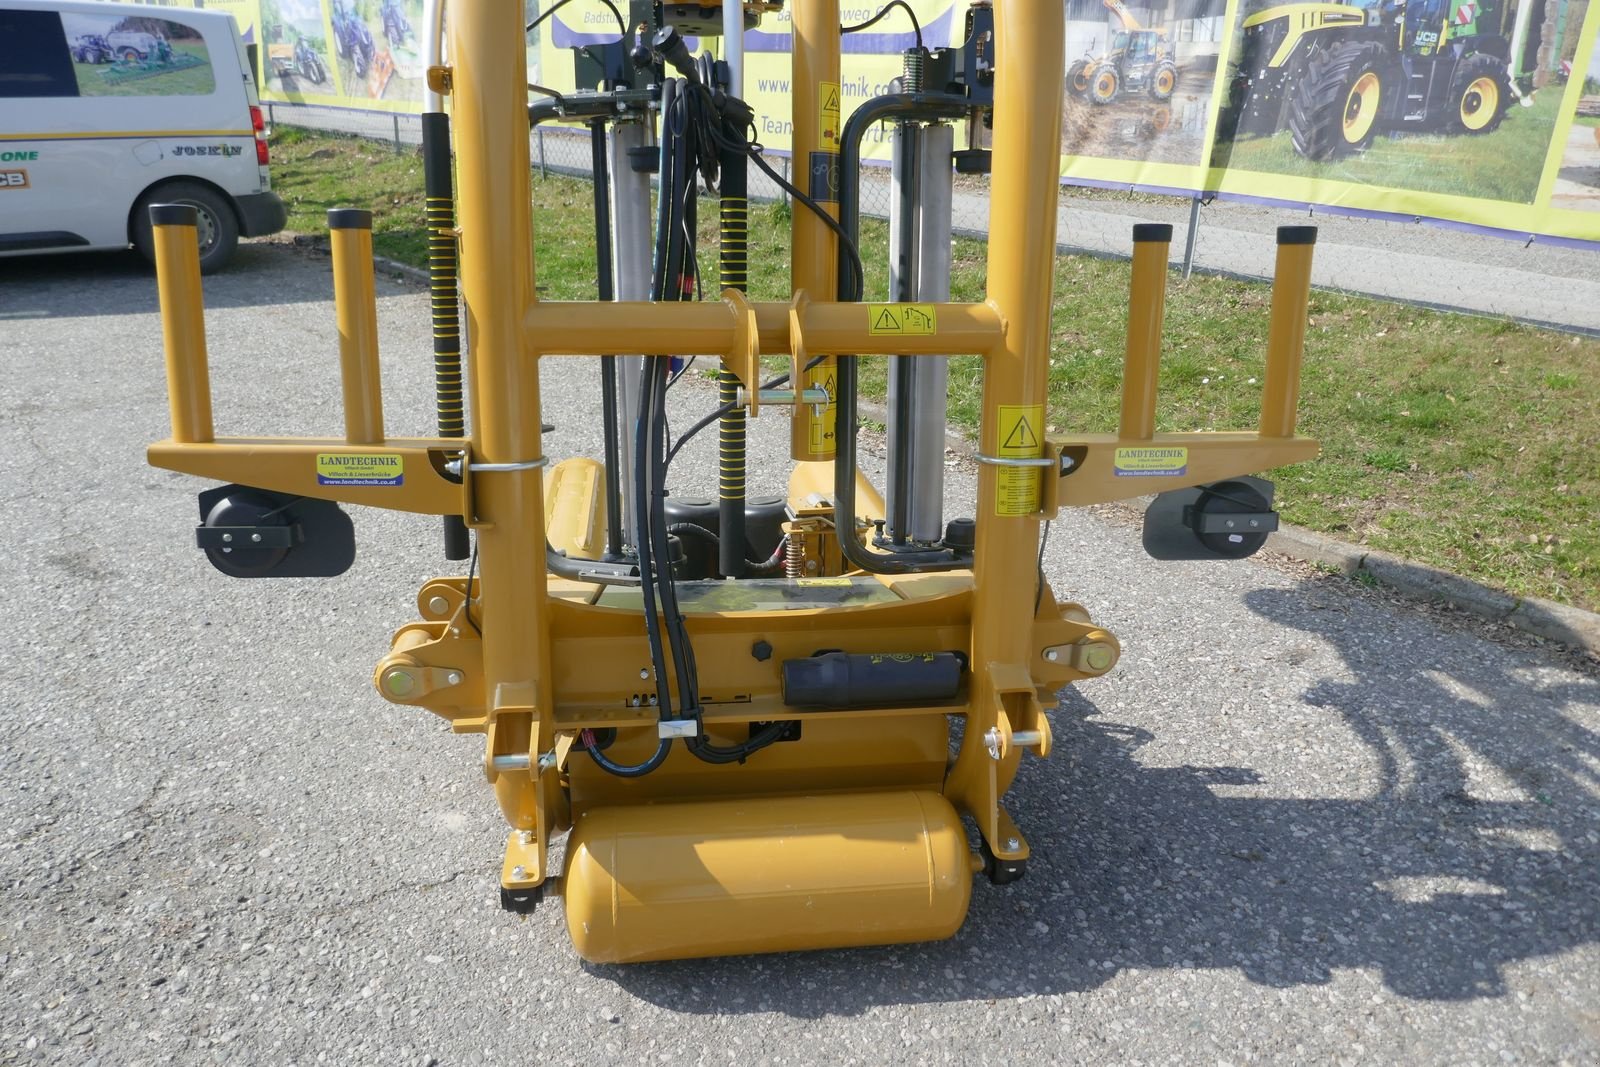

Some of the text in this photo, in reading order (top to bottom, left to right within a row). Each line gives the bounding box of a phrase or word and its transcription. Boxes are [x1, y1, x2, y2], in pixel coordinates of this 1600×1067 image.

[1416, 31, 1438, 42] JCB
[1, 151, 39, 162] ONE
[172, 145, 242, 157] JOSKIN
[1118, 450, 1184, 458] LANDTECHNIK
[320, 457, 398, 466] LANDTECHNIK
